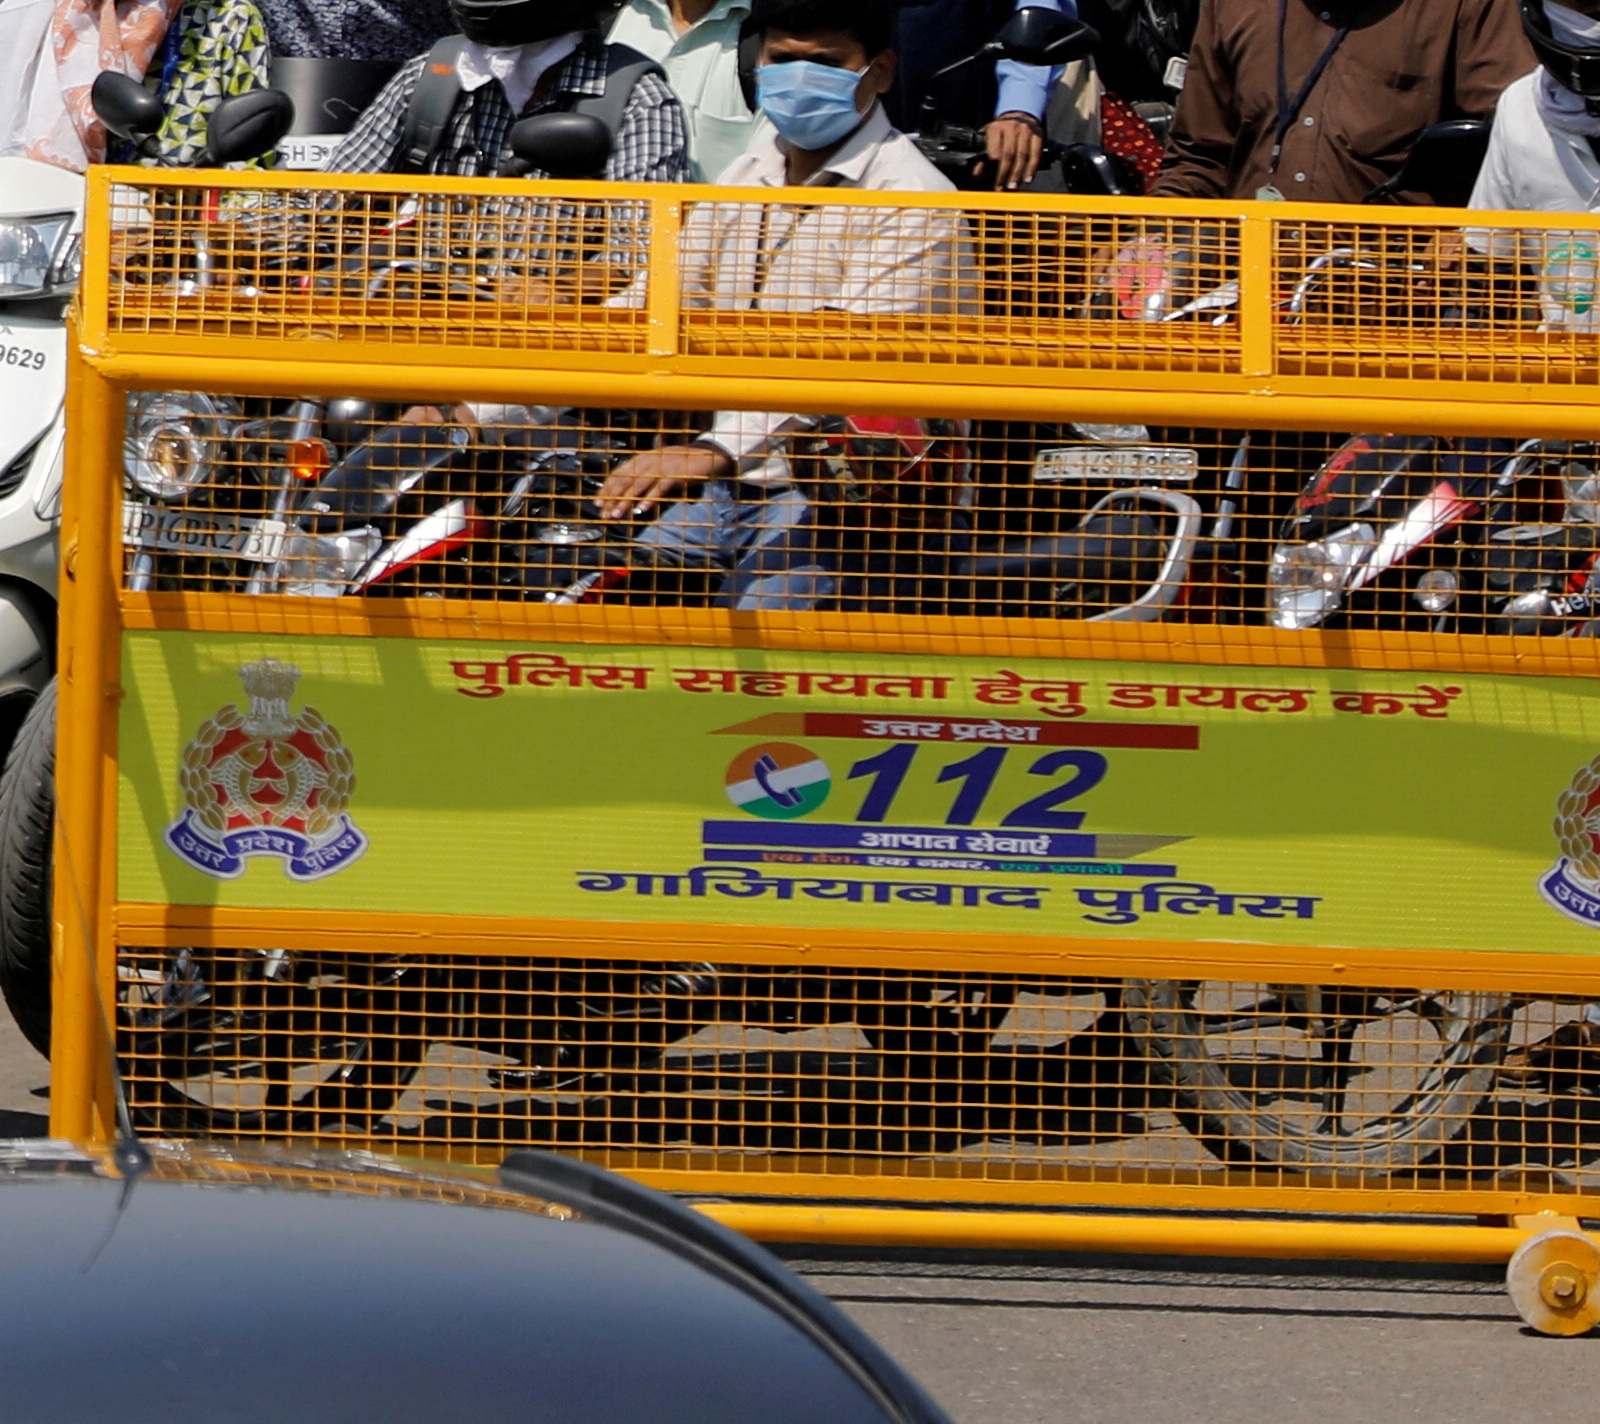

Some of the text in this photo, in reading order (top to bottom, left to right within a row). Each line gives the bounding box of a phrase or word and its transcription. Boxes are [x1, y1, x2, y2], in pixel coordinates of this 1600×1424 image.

[451, 653, 1465, 719] पुलिस सहायता हेतु डायल करें
[862, 719, 1042, 742] उत्तर प्रदेश
[846, 742, 1110, 830] 112
[857, 830, 1053, 855] आपात सेवाएं
[575, 866, 1324, 925] गाजियाबाद पुलिस
